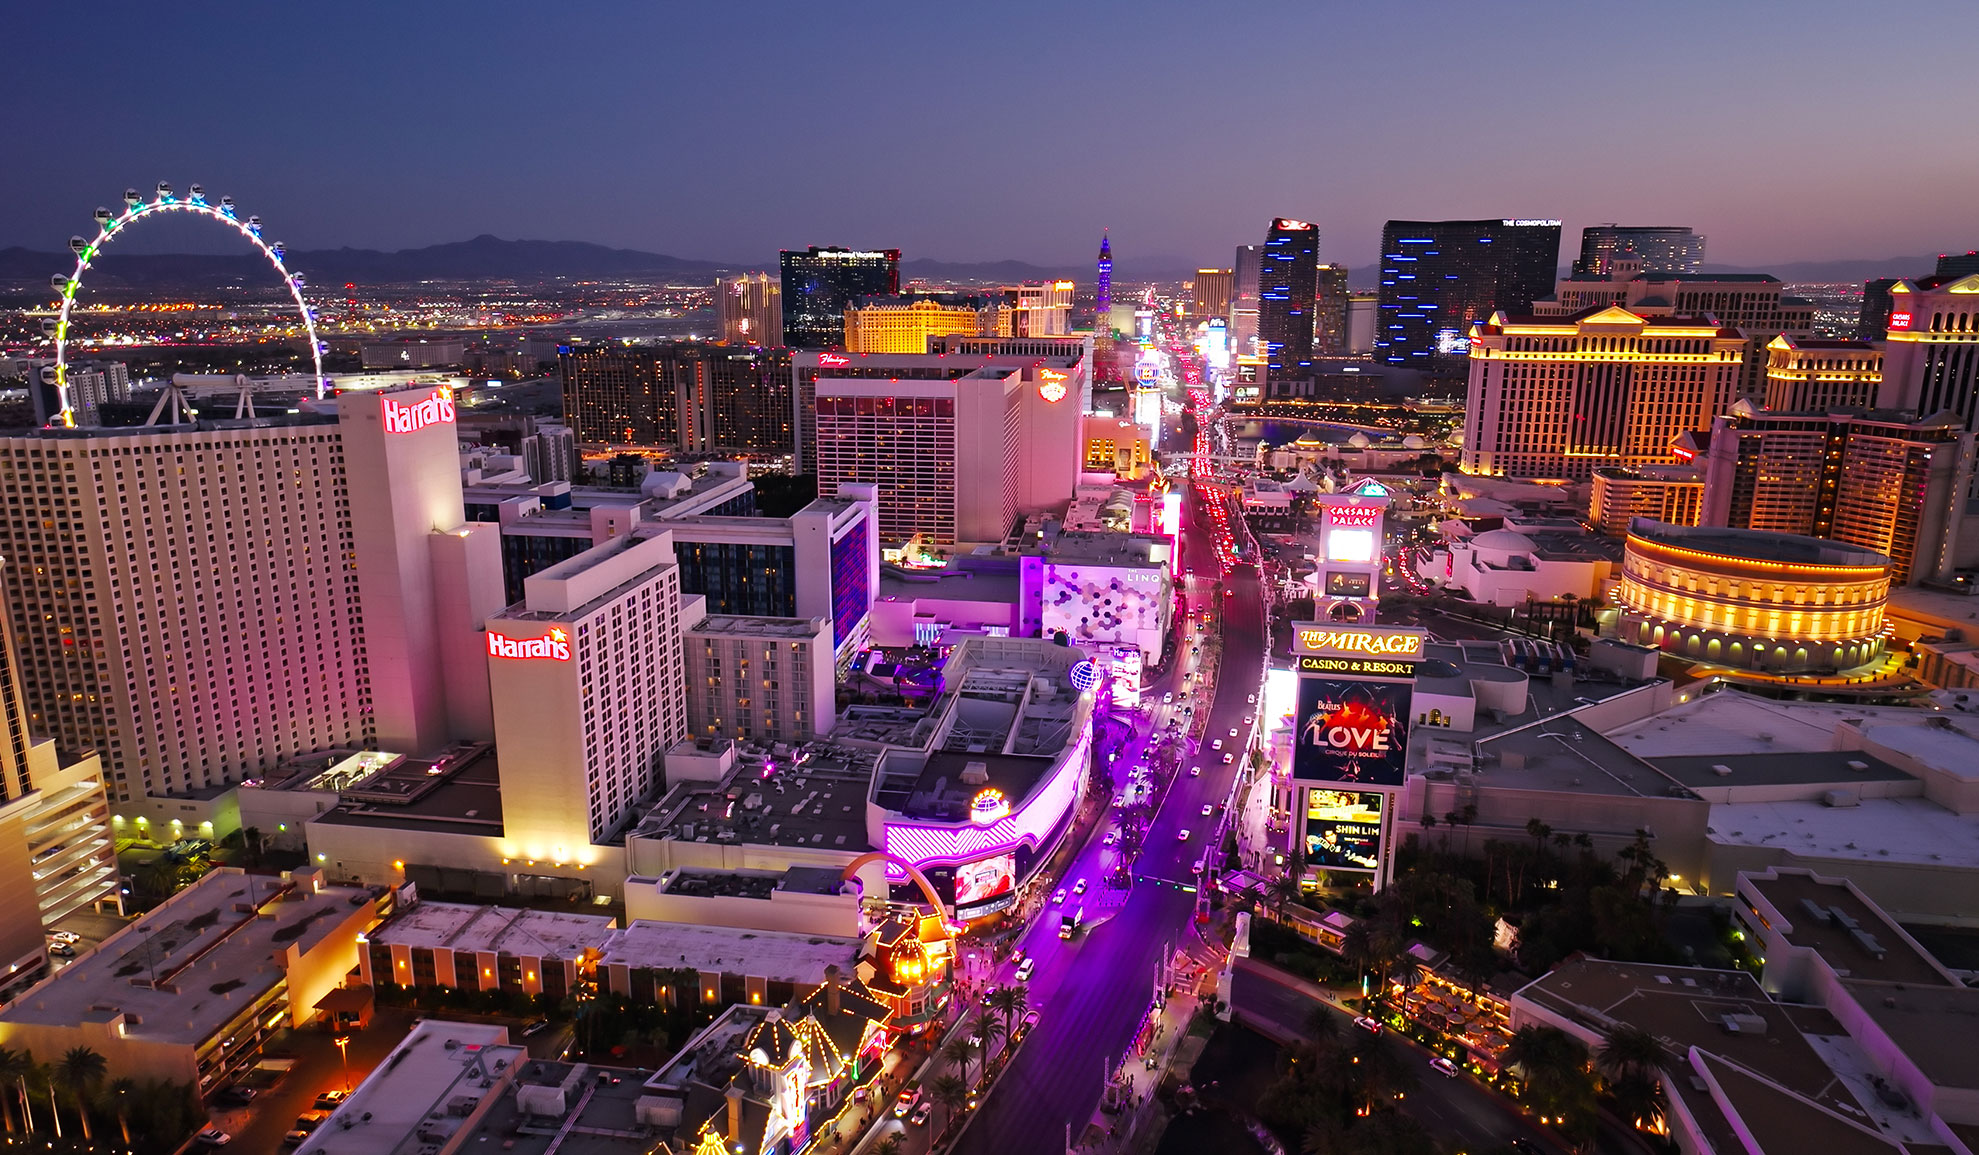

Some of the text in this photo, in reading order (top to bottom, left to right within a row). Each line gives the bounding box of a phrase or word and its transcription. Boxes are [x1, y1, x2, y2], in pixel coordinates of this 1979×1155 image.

[1330, 507, 1377, 517] CAESARS
[1332, 516, 1374, 526] PALACE
[1127, 574, 1160, 582] LINQ
[1300, 631, 1419, 654] THE MIRAGE
[1302, 658, 1414, 674] CASINO & RESORT
[1313, 724, 1390, 750] LOVE
[1336, 825, 1379, 836] SHIN LIM
